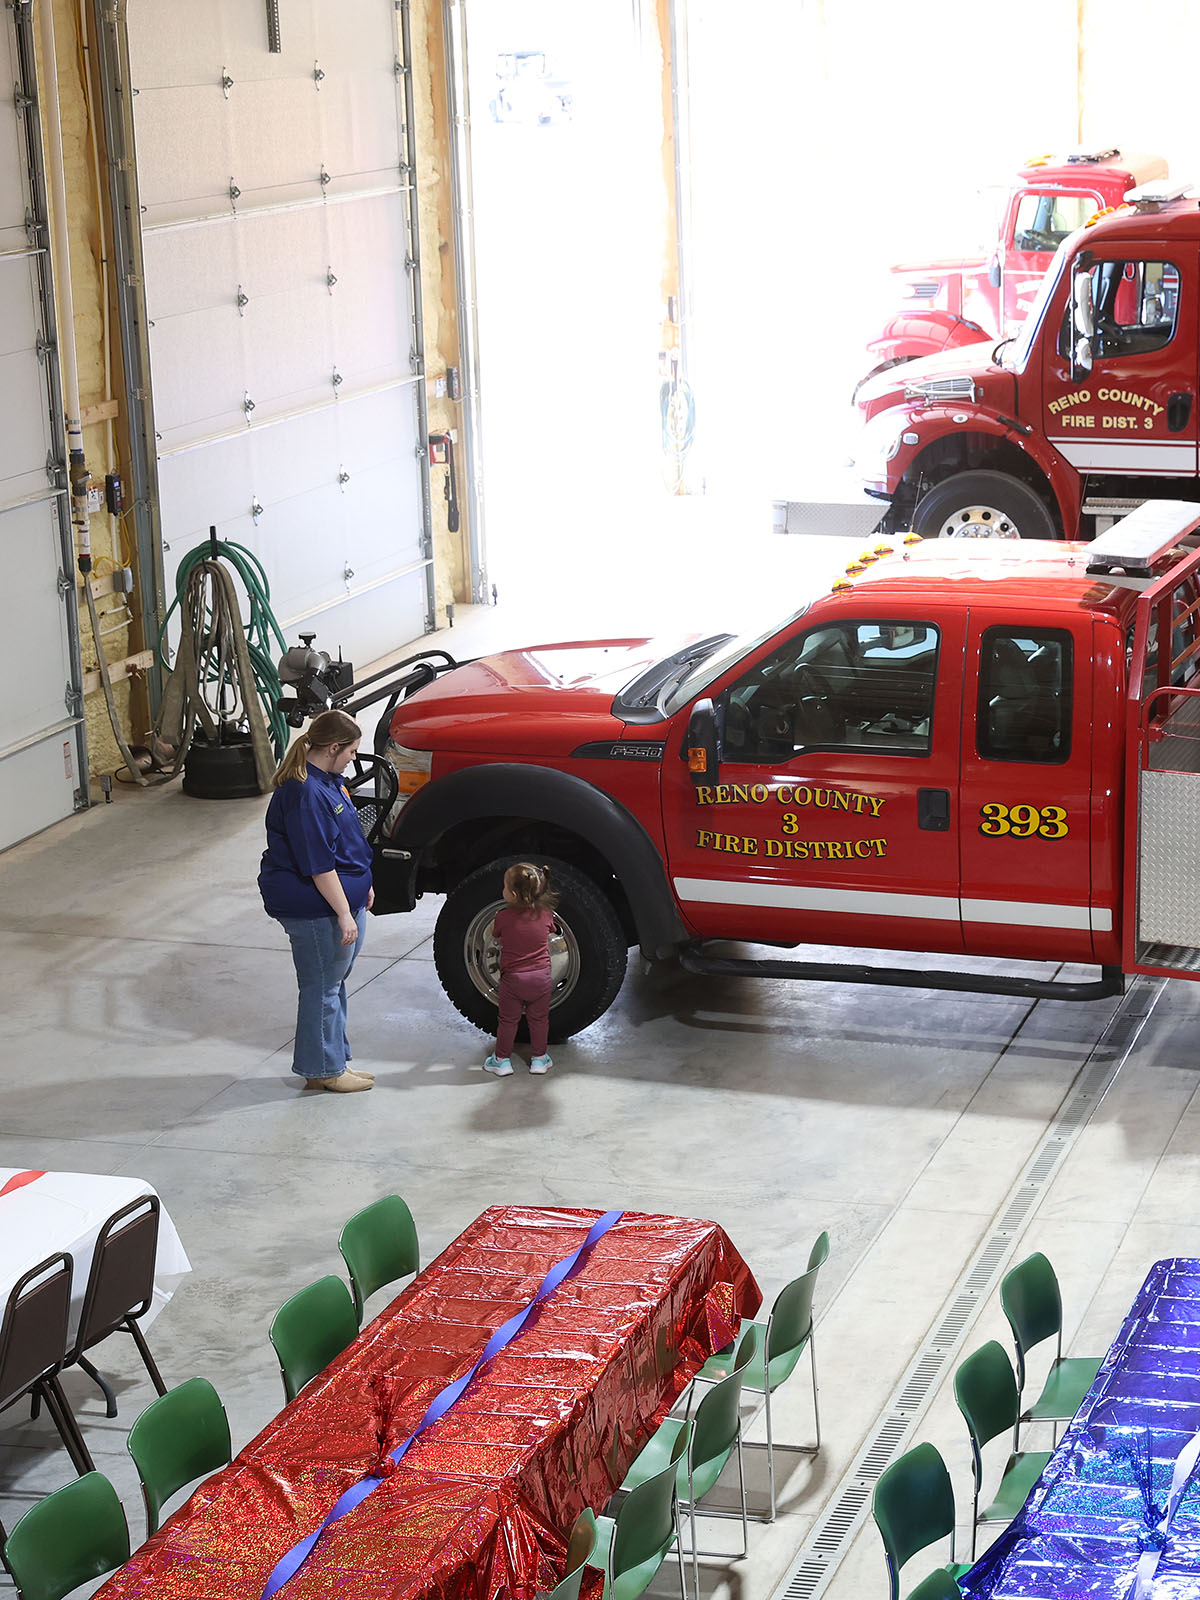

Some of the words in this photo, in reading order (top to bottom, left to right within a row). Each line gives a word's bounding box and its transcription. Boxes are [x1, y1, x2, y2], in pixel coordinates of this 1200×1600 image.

[1047, 389, 1091, 415] RENO
[1097, 388, 1165, 417] COUNTY
[1061, 415, 1096, 428] FIRE
[1102, 416, 1138, 429] DIST.
[1143, 417, 1154, 430] 3
[695, 783, 770, 806] RENO
[777, 785, 887, 818] COUNTY
[781, 811, 800, 836] 3
[978, 802, 1070, 841] 393
[695, 829, 759, 856] FIRE
[764, 837, 888, 861] DISTRICT
